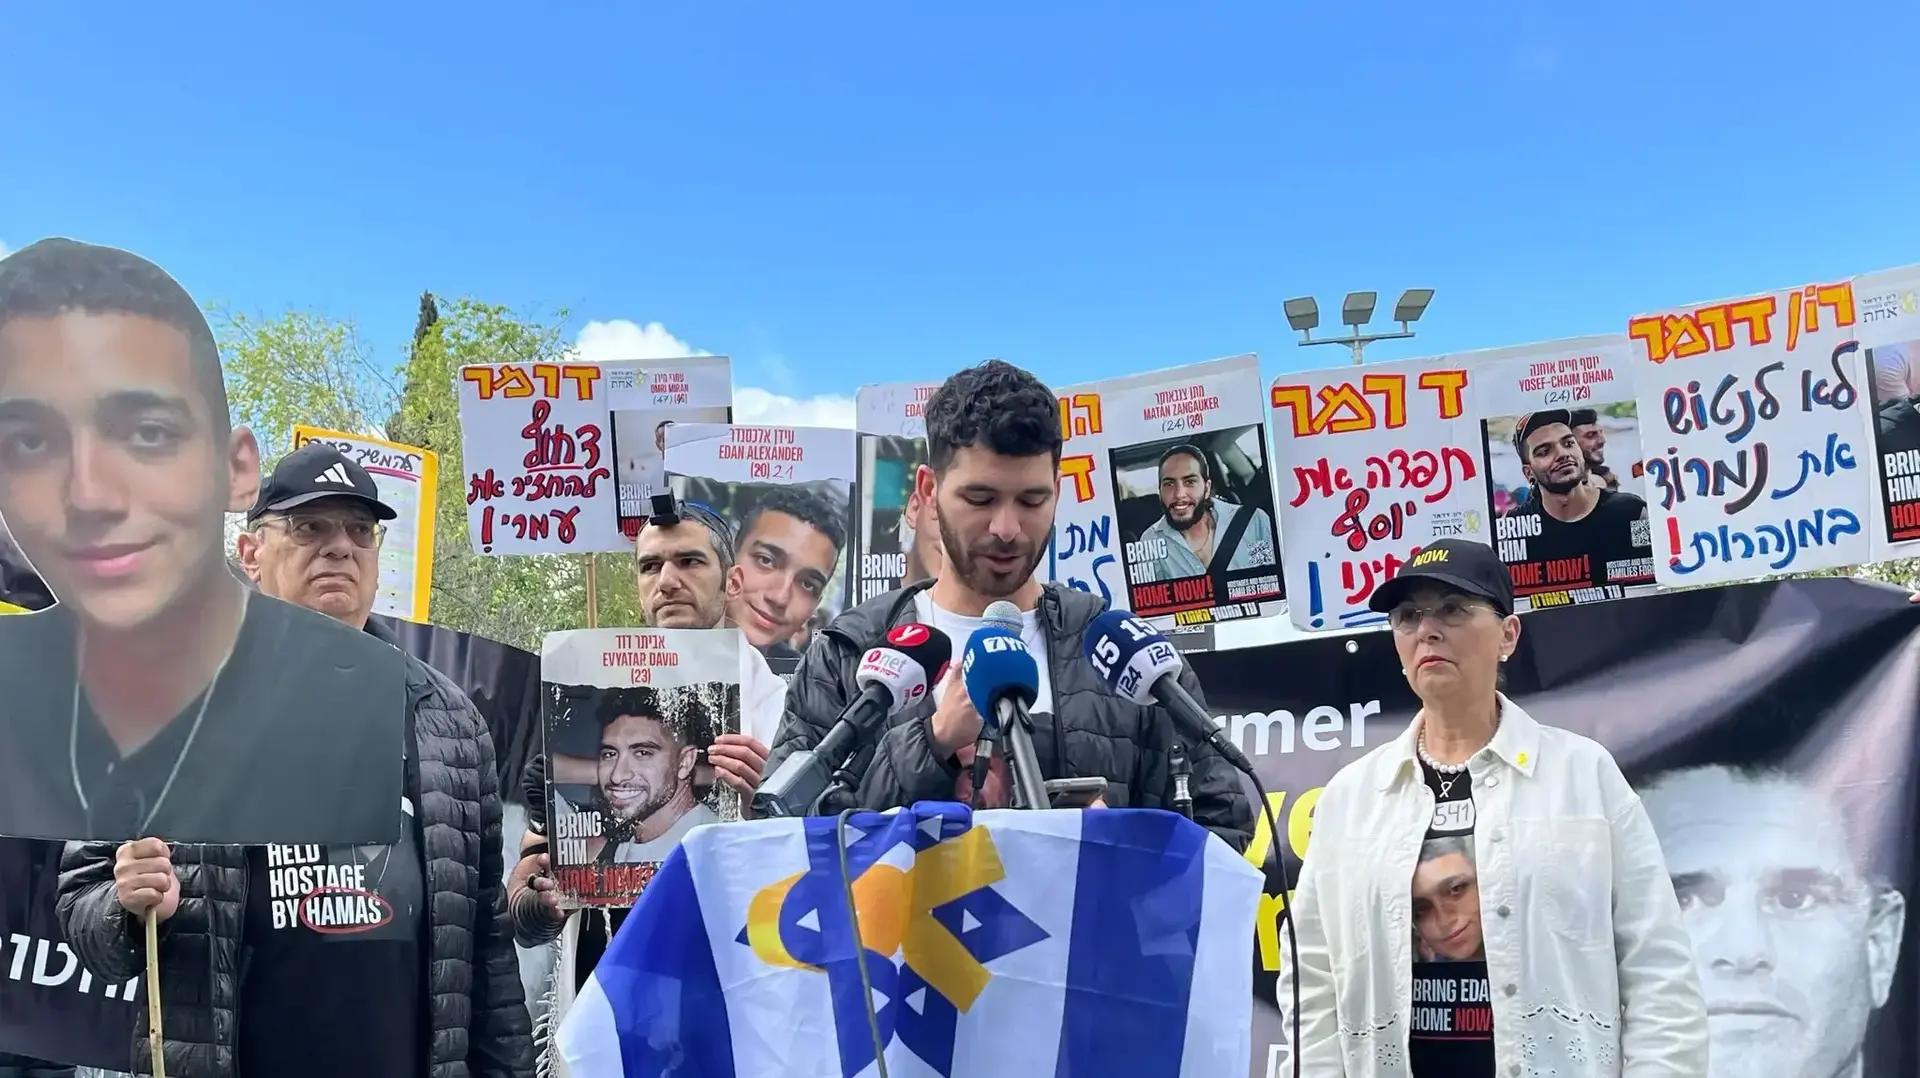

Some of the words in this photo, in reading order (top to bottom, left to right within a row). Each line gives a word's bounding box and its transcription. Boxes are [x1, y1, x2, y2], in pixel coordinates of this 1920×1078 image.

[1786, 280, 1856, 352] רון
[1863, 306, 1898, 323] אחת
[1629, 296, 1777, 364] דרמר
[1530, 361, 1557, 376] אוחנה
[1559, 359, 1578, 373] חיים
[1580, 356, 1599, 371] יוסף
[1801, 340, 1860, 412] לא
[463, 365, 600, 400] דרמר
[611, 380, 633, 389] אחת
[650, 384, 667, 394] OMRI
[668, 383, 689, 393] MIRAN
[1519, 373, 1580, 392] YOSEF-CHAIM
[1582, 368, 1614, 384] OHANA
[1143, 405, 1171, 421] MATAN
[1172, 396, 1220, 416] ZANGAUKER
[1544, 390, 1570, 405] (24)
[1663, 361, 1785, 443] לנטוש
[730, 428, 772, 444] אלכסנדר
[775, 429, 795, 444] עידן
[1161, 418, 1185, 433] (24)
[719, 446, 744, 460] EDAN
[746, 446, 804, 462] ALEXANDER
[1771, 433, 1857, 500] את
[1884, 448, 1920, 478] BRIN
[750, 462, 770, 478] (20)
[772, 465, 794, 479] 21
[1365, 447, 1477, 504] תפדה
[1645, 442, 1769, 515] נמרוד
[466, 469, 505, 506] את
[620, 484, 652, 500] BRING
[1290, 458, 1354, 508] את
[1888, 475, 1920, 502] HIM
[620, 500, 641, 517] HIM
[1331, 488, 1417, 551] יוסף
[1891, 502, 1920, 529] HO
[1432, 525, 1463, 537] אחת
[1496, 514, 1542, 540] BRING
[1126, 538, 1168, 563] BRING
[1498, 539, 1528, 562] HIM
[861, 553, 907, 578] BRING
[1130, 562, 1157, 585] HIM
[1507, 563, 1543, 587] OME
[1546, 553, 1592, 584] NOW!
[1606, 567, 1638, 580] FAMILIES
[1132, 584, 1173, 608] HOME
[1173, 574, 1215, 602] NOW!
[1604, 584, 1622, 599] עד
[1241, 602, 1258, 616] עד
[616, 635, 632, 650] דוד
[634, 635, 666, 650] אביתר
[1120, 618, 1158, 642] 15
[602, 652, 646, 667] EVYATAR
[649, 652, 679, 666] DAVID
[1091, 634, 1121, 680] 15
[1147, 645, 1175, 667] i24
[630, 669, 651, 684] (23)
[1119, 665, 1142, 698] i24
[556, 810, 602, 838] BRING
[267, 843, 321, 868] HELD
[557, 840, 588, 865] HIM
[269, 865, 366, 898] HOSTAGE
[271, 899, 300, 930] BY
[305, 896, 382, 926] HAMAS
[1413, 978, 1457, 1003] BRING
[1460, 978, 1490, 1002] EDA
[1411, 1007, 1452, 1032] HOME
